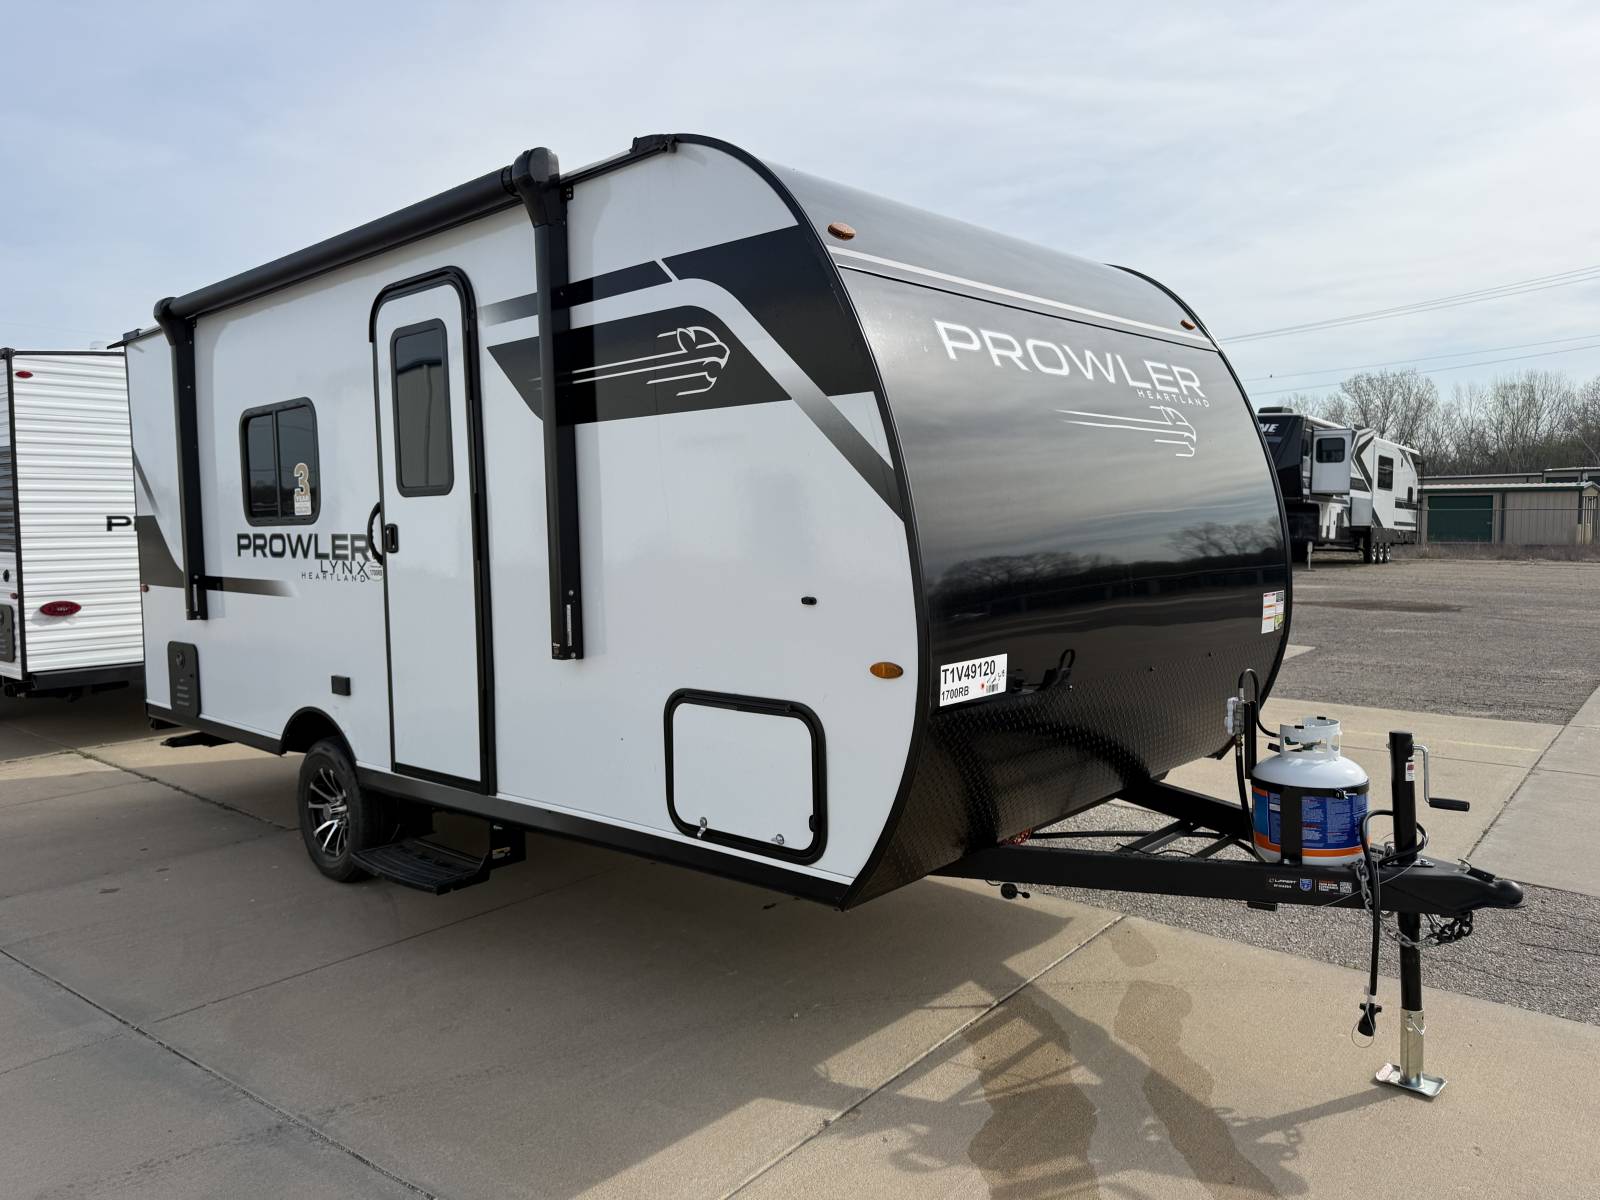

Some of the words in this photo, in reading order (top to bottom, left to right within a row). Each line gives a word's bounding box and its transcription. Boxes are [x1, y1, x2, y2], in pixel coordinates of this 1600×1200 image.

[934, 320, 1206, 398] PROWLER
[1137, 389, 1210, 409] HEARTLAND
[294, 463, 310, 496] 3
[237, 533, 370, 562] PROWLER
[301, 572, 366, 582] HEARTLAND
[320, 560, 370, 580] LYNX
[942, 660, 996, 685] T1V49120
[941, 685, 969, 702] 1700RB
